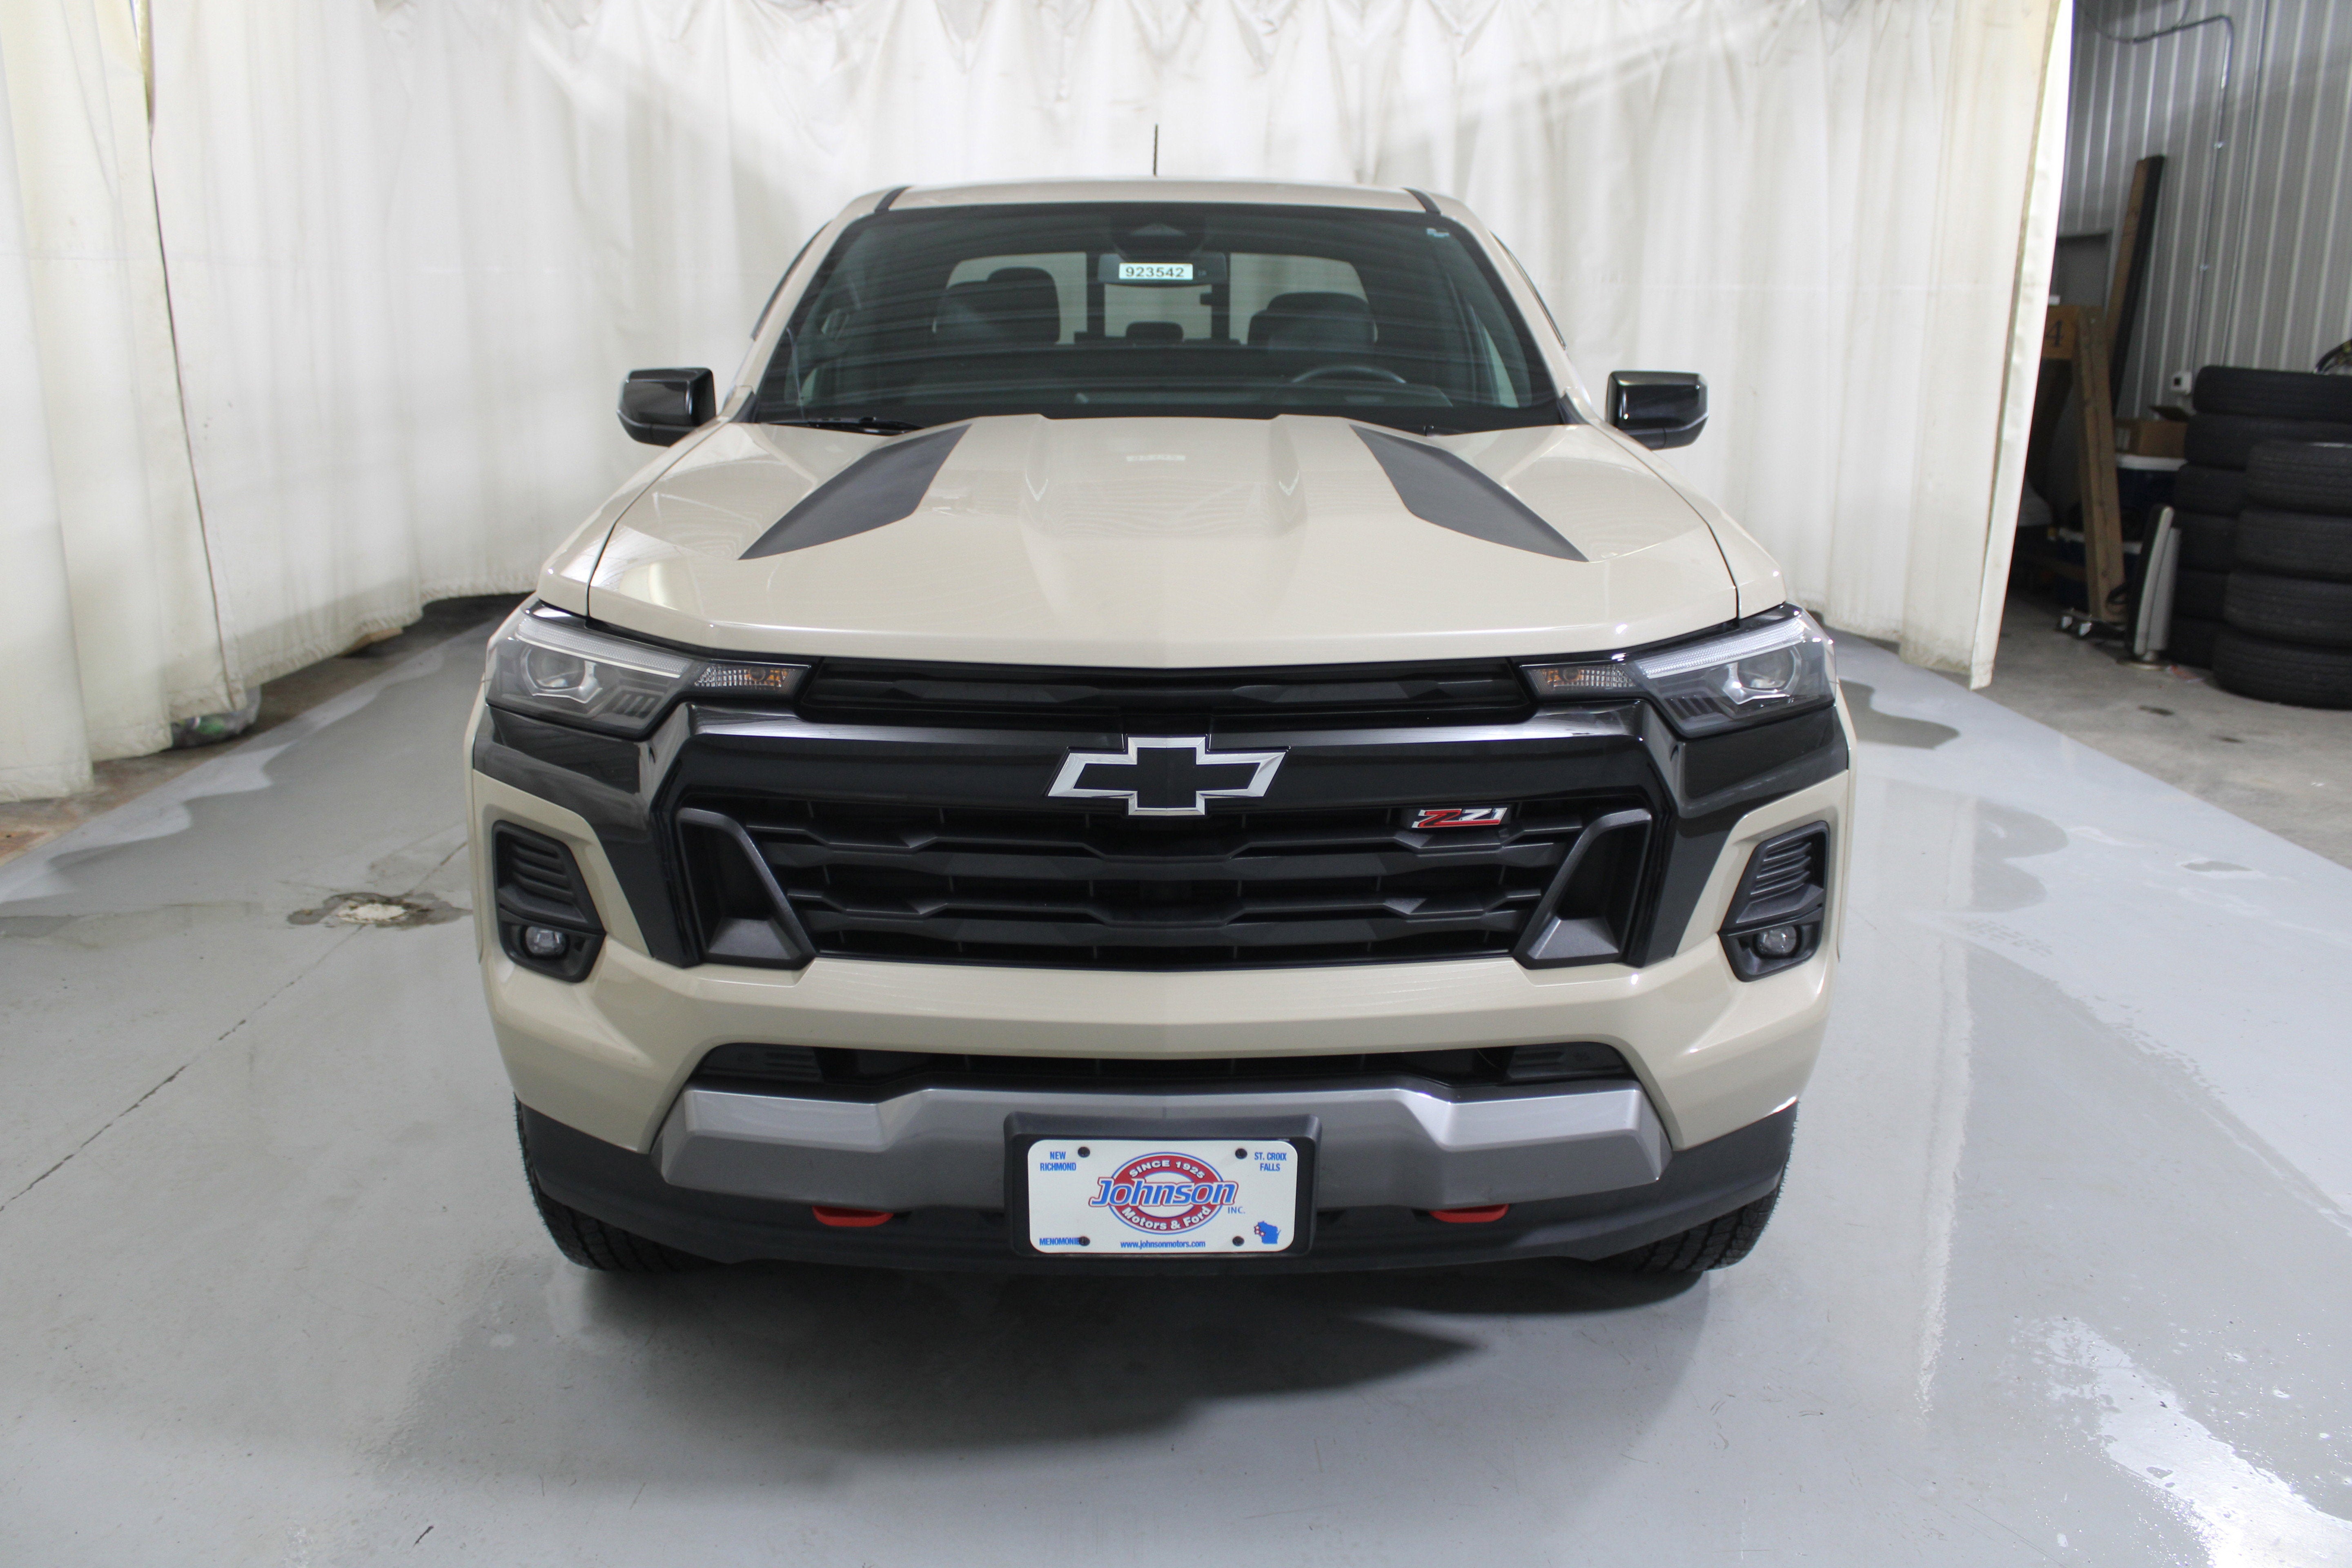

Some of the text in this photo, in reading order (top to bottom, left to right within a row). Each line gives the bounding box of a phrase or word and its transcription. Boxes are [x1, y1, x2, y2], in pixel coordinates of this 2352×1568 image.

[1126, 267, 1184, 277] 923542
[1412, 807, 1508, 828] Z71
[1050, 1151, 1066, 1160] NEW
[1267, 1152, 1287, 1160] CROIX
[1040, 1163, 1077, 1171] RICHMOND
[1129, 1160, 1206, 1179] SINCE 1925
[1260, 1163, 1280, 1171] FALLS
[1090, 1178, 1237, 1206] Johnson
[1122, 1206, 1212, 1230] Motors & Ford
[1120, 1240, 1205, 1250] www.johnsonmotors.com
